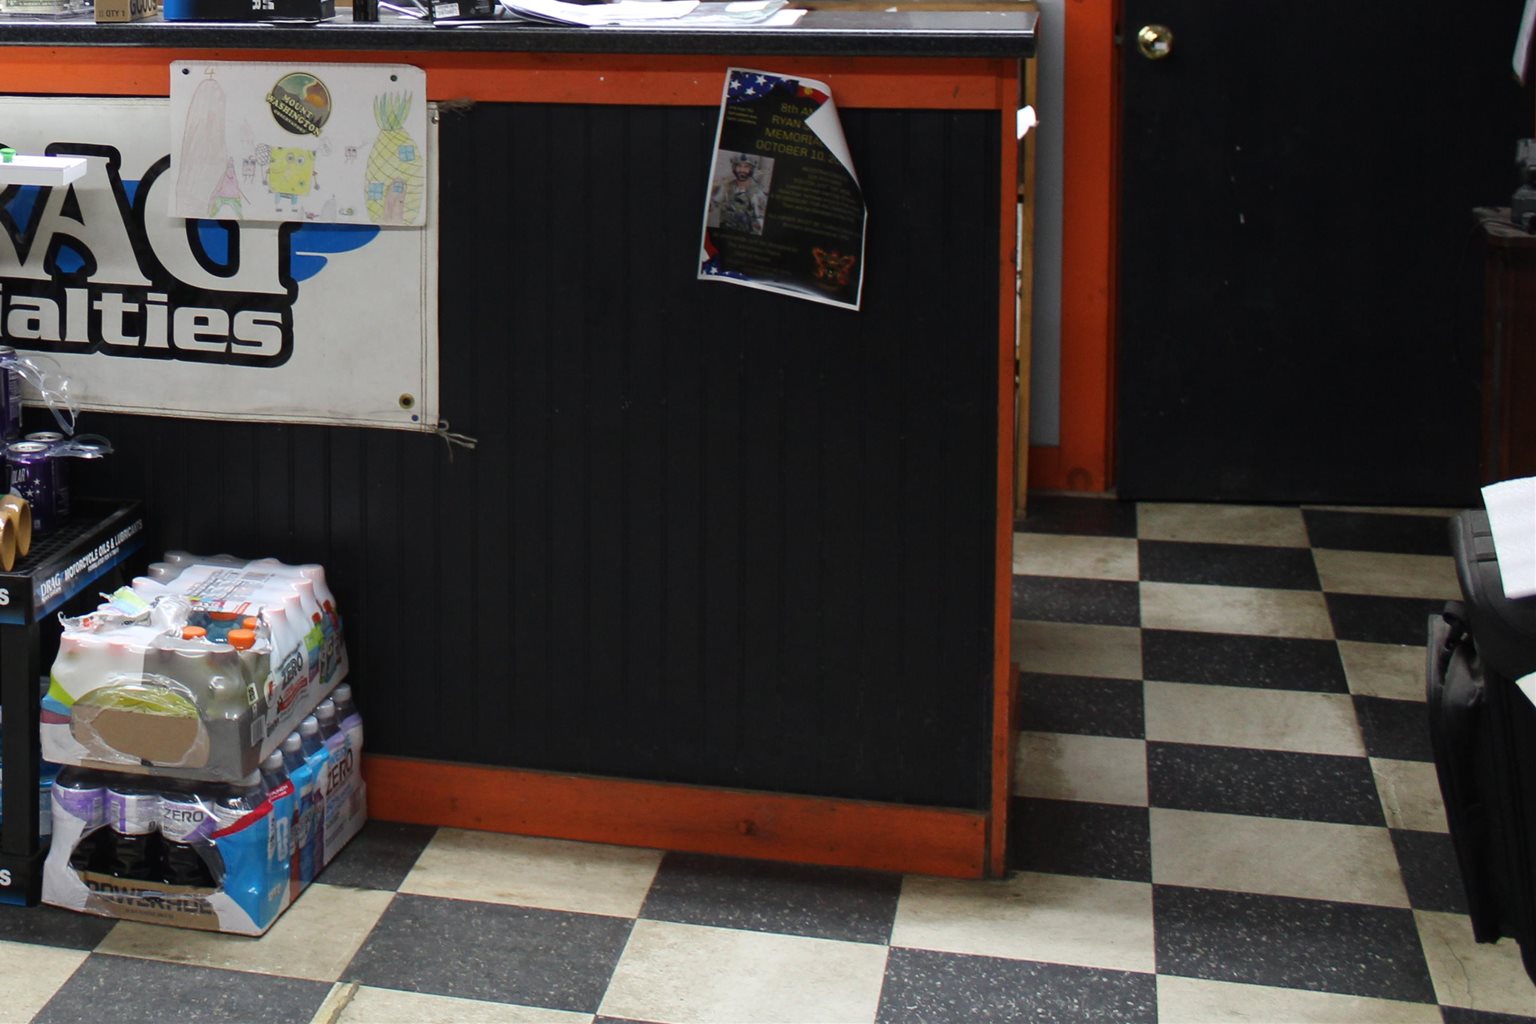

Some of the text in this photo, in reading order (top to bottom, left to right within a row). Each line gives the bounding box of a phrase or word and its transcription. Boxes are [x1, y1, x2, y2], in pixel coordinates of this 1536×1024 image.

[266, 93, 321, 137] WASHINGTON
[283, 94, 313, 119] MOUNT
[781, 103, 799, 114] 8th
[771, 115, 802, 128] RYAN
[755, 139, 809, 156] OCTOBER
[764, 128, 824, 147] MEMORIA
[64, 548, 98, 581] MOTORCYCLE
[98, 540, 110, 557] OILS
[40, 573, 61, 596] DRAG
[326, 748, 353, 796] ZERO
[164, 808, 203, 823] ZERO
